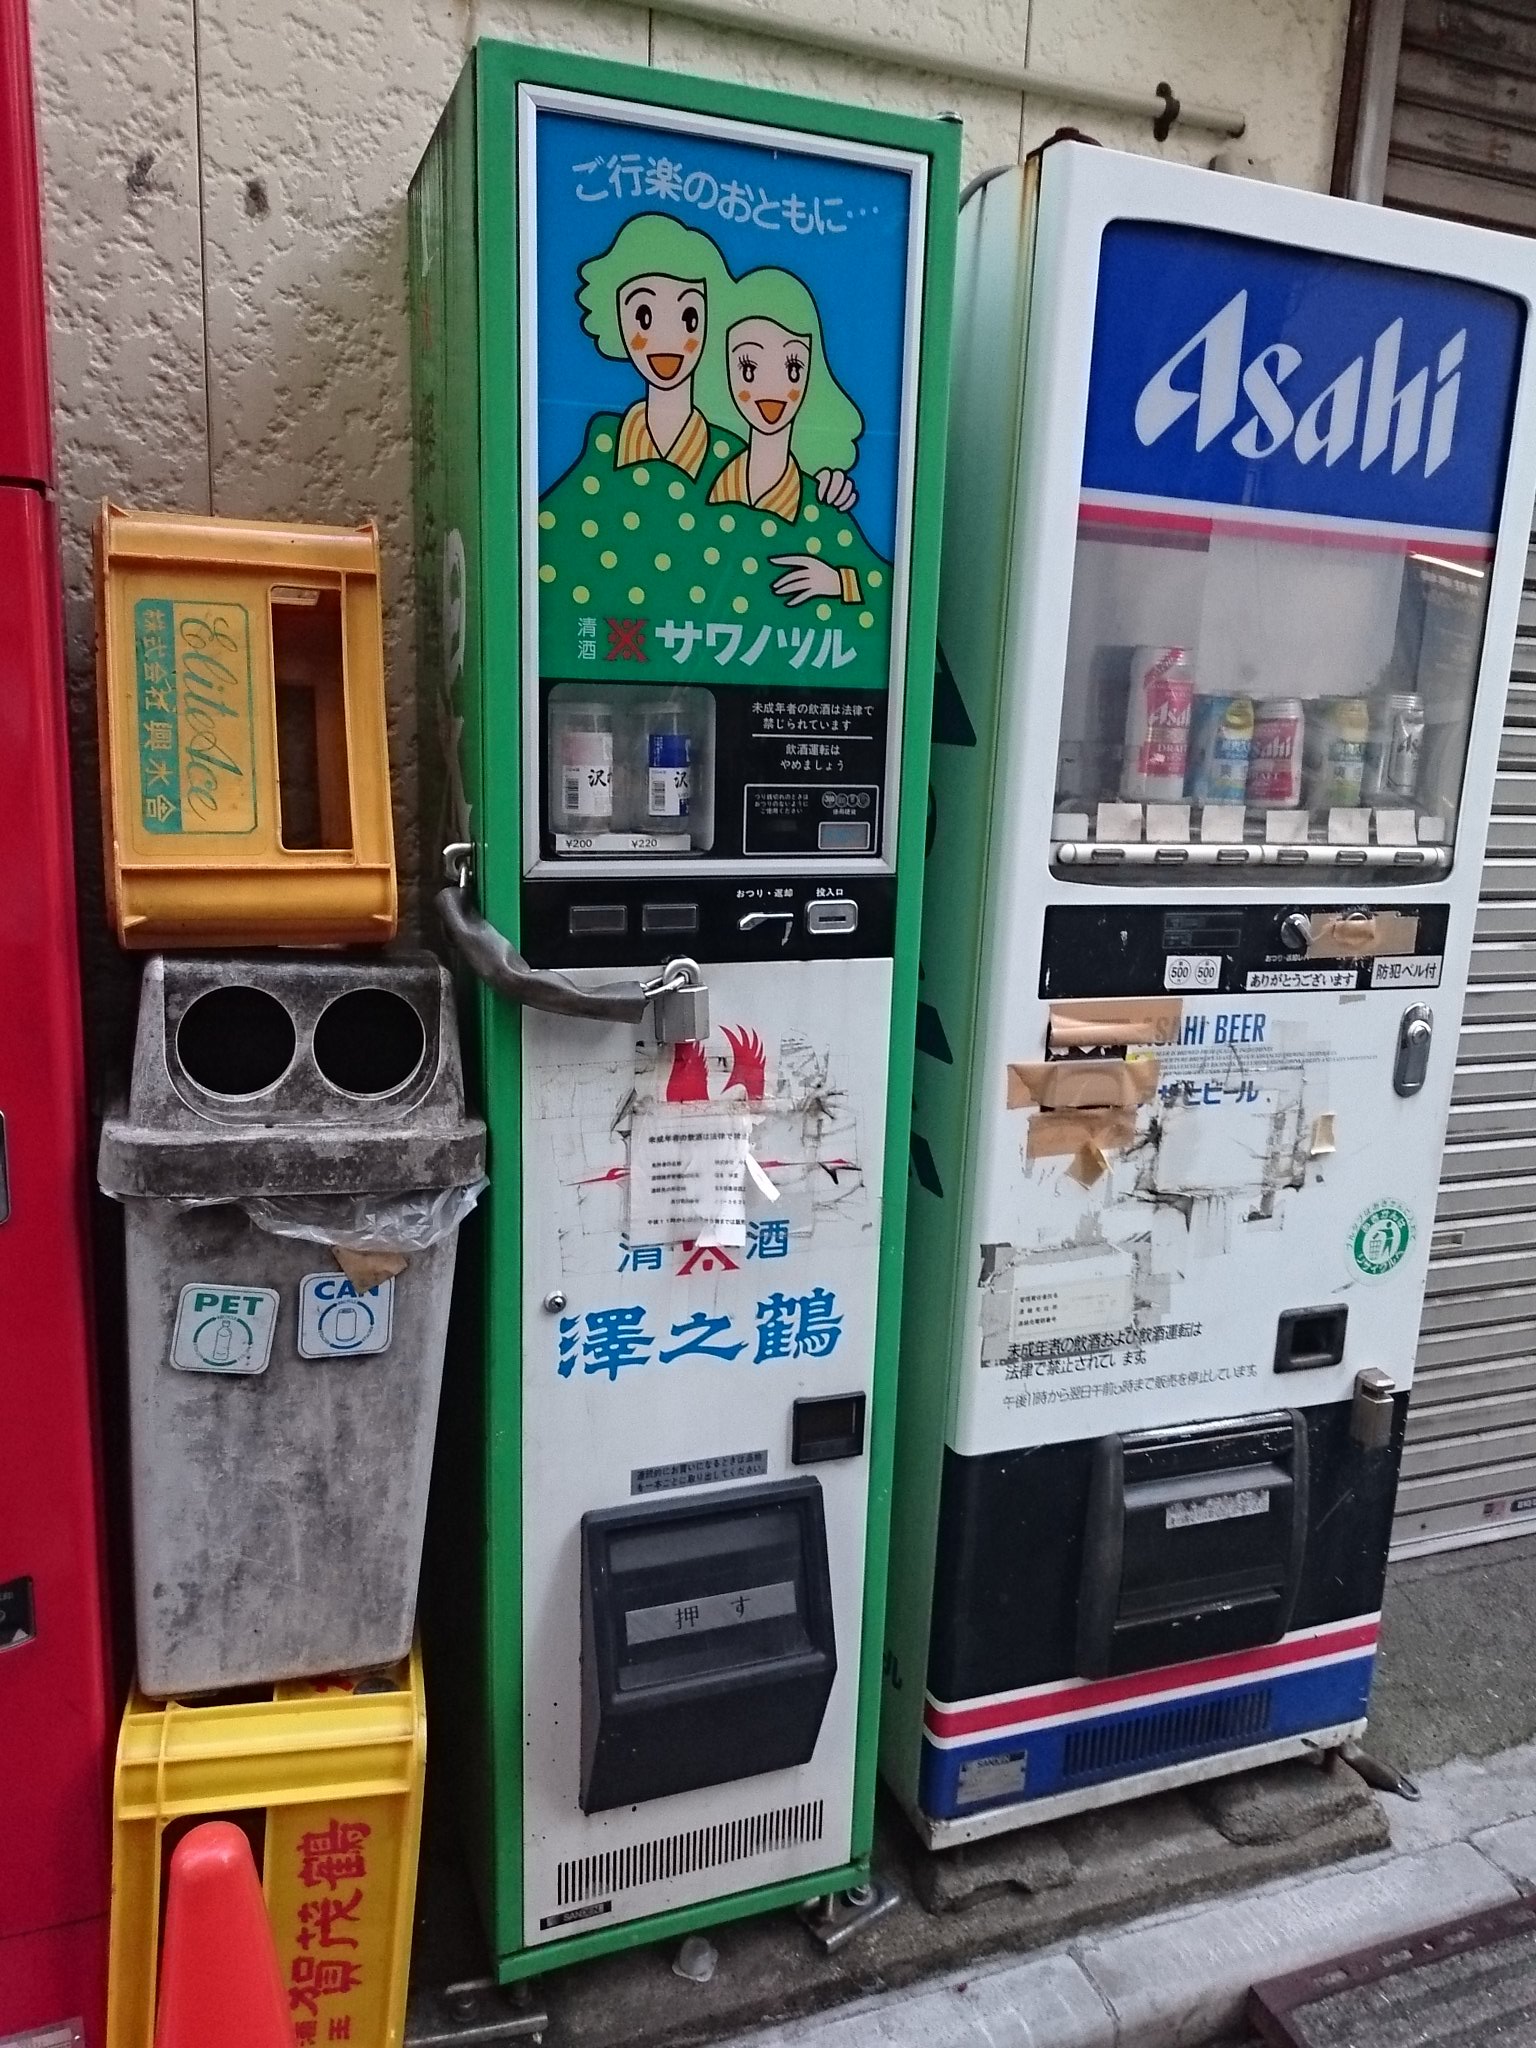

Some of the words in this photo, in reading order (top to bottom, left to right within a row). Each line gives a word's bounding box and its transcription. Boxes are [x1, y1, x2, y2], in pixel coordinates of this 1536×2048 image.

[1134, 288, 1468, 479] Asahi
[577, 616, 598, 660] 清酒
[654, 618, 858, 670] サワノツル
[751, 702, 875, 716] 未成年者の飲酒は法律で
[763, 718, 852, 731] 禁じられています
[785, 743, 841, 756] 飲酒運転は
[780, 759, 844, 772] やめましょう
[565, 839, 593, 849] ¥200
[631, 838, 658, 849] ¥220
[736, 887, 794, 899] おつり・返却
[815, 886, 844, 898] 投入口
[1170, 966, 1189, 978] 500
[1197, 966, 1215, 978] 500
[1375, 962, 1438, 981] 防犯ベル付
[1250, 973, 1355, 989] ありがとうございます
[1213, 1012, 1267, 1045] BEER
[745, 1219, 791, 1260] 酒
[194, 1293, 264, 1316] PET
[557, 1287, 845, 1382] 澤之鶴
[288, 1817, 373, 2016] 賀茂鶴
